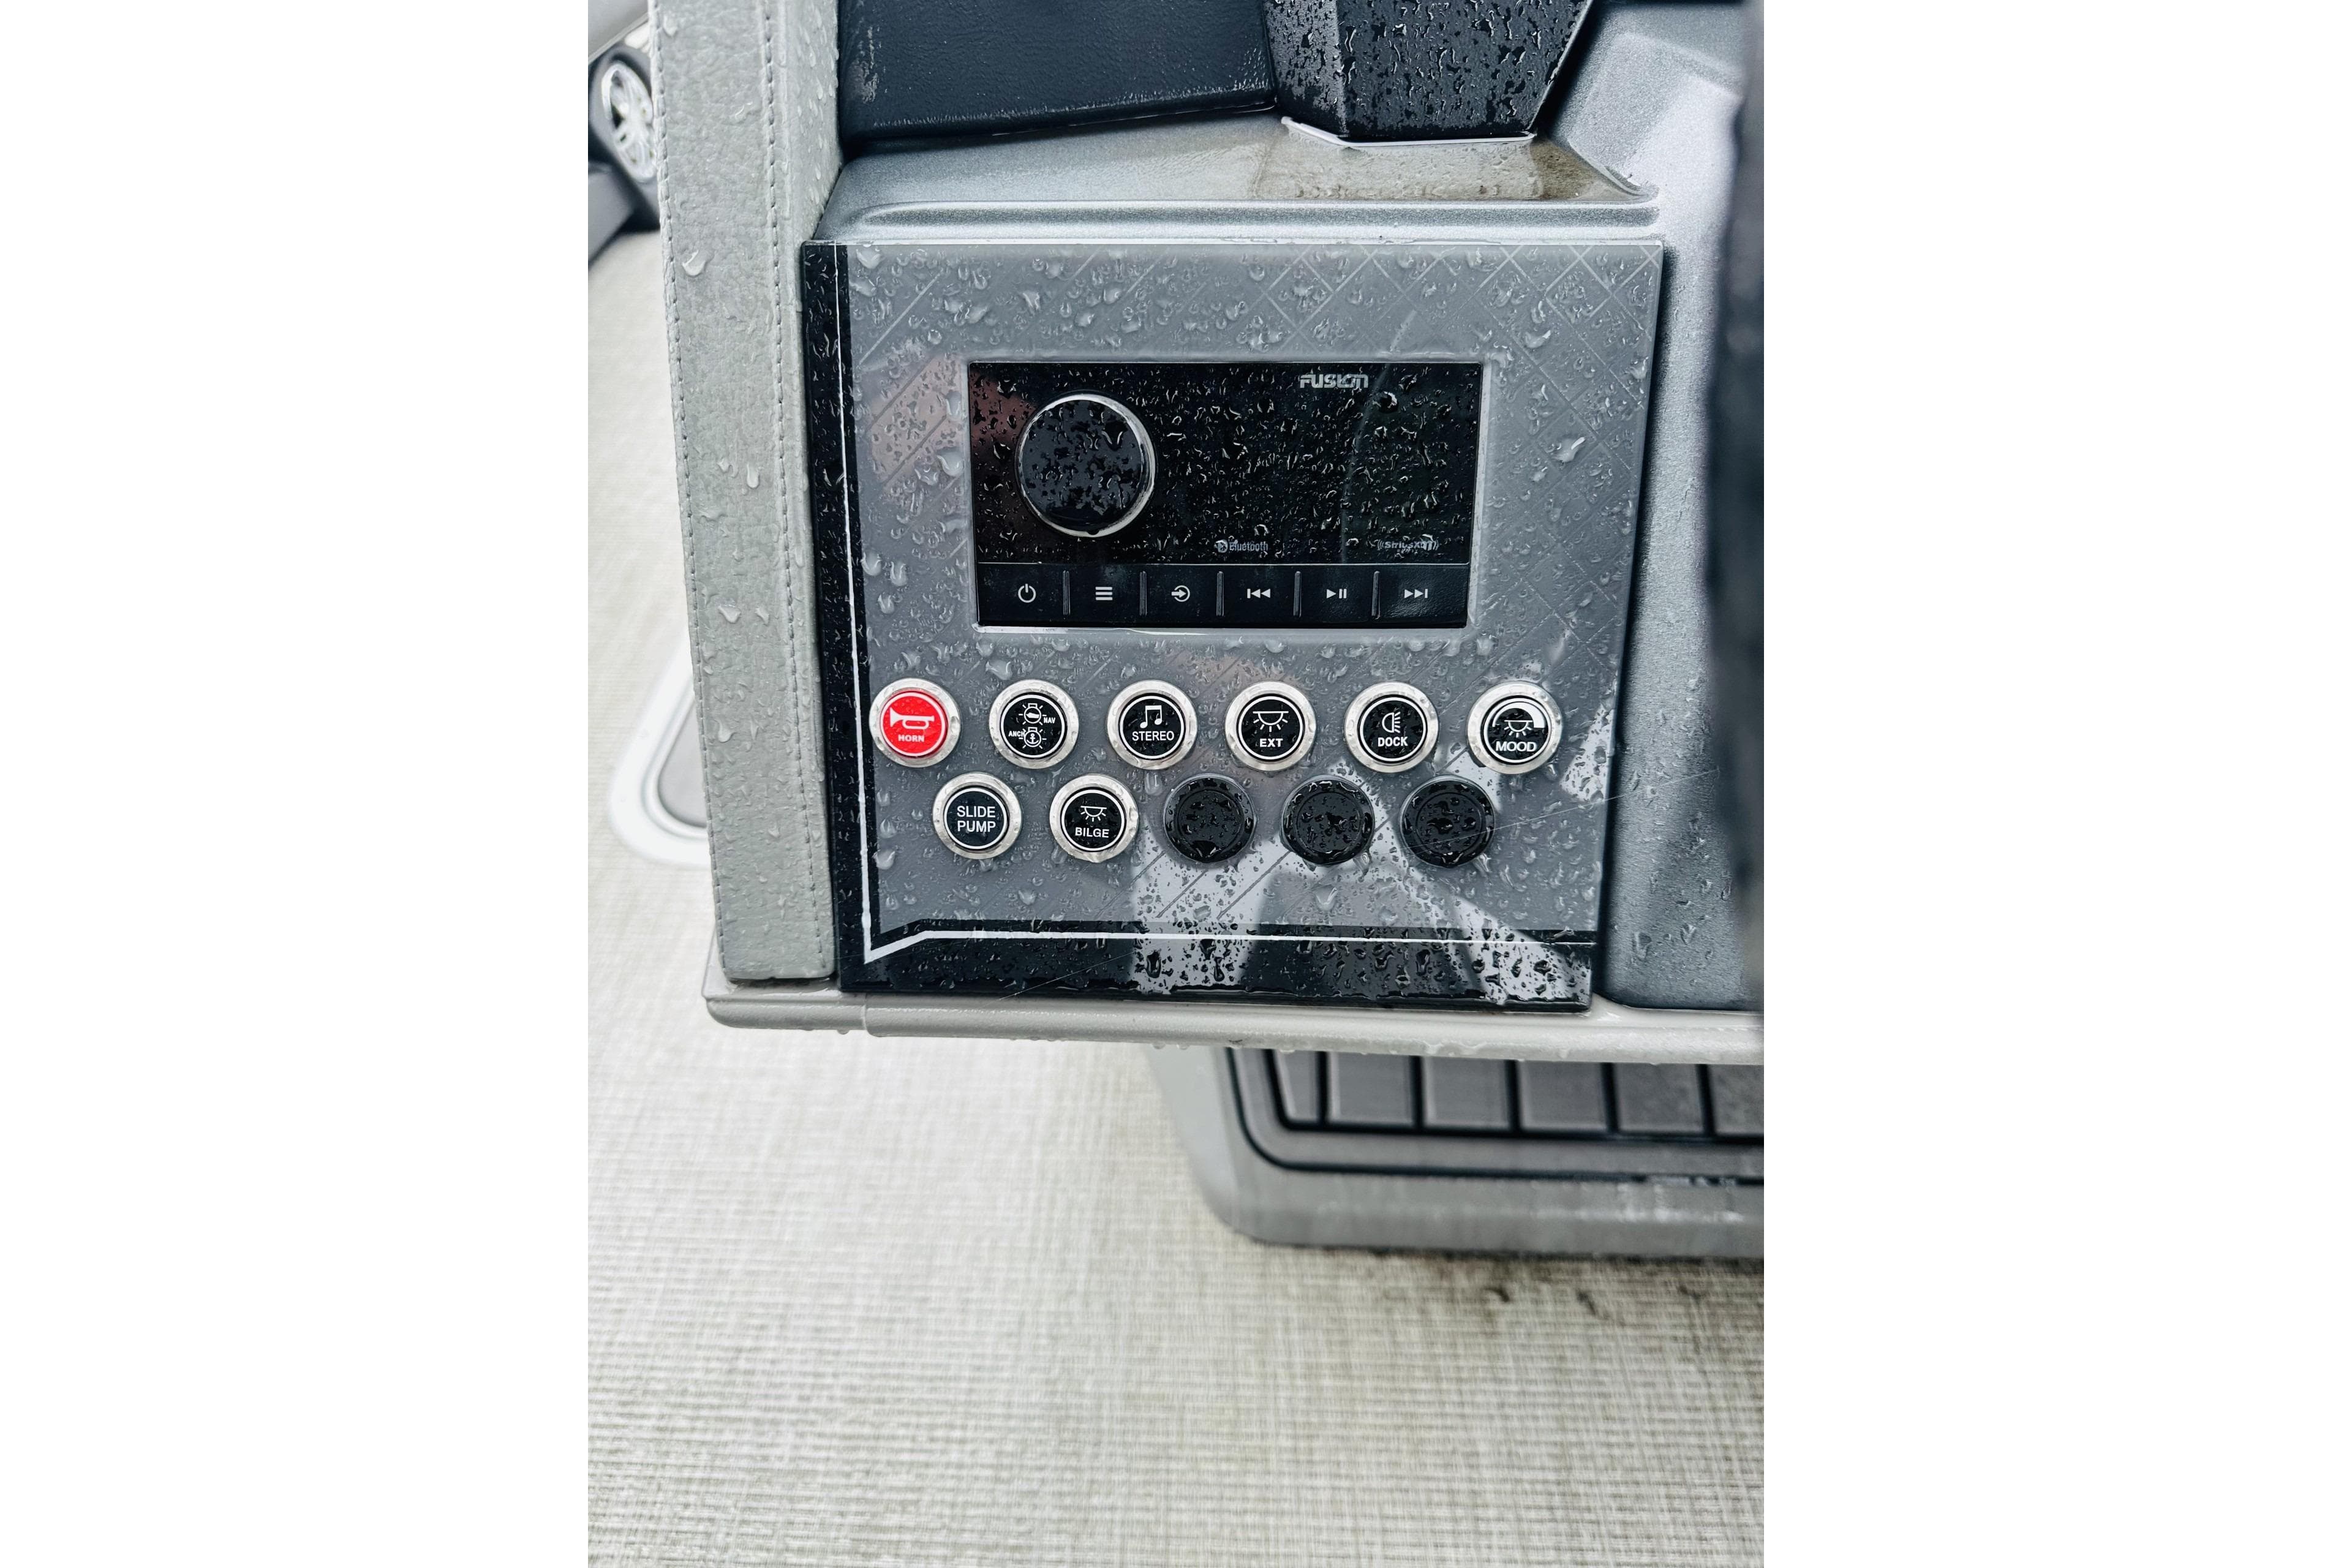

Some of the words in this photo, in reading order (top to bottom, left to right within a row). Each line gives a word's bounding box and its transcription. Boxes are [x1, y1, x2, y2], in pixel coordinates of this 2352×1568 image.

[1132, 731, 1175, 742] STEREO
[1378, 736, 1408, 747] DOCK
[1259, 738, 1283, 748] EXT
[1495, 741, 1537, 752] MOOD
[956, 805, 996, 818] SLIDE
[957, 821, 997, 833] PUMP
[1074, 827, 1109, 839] BILGE
